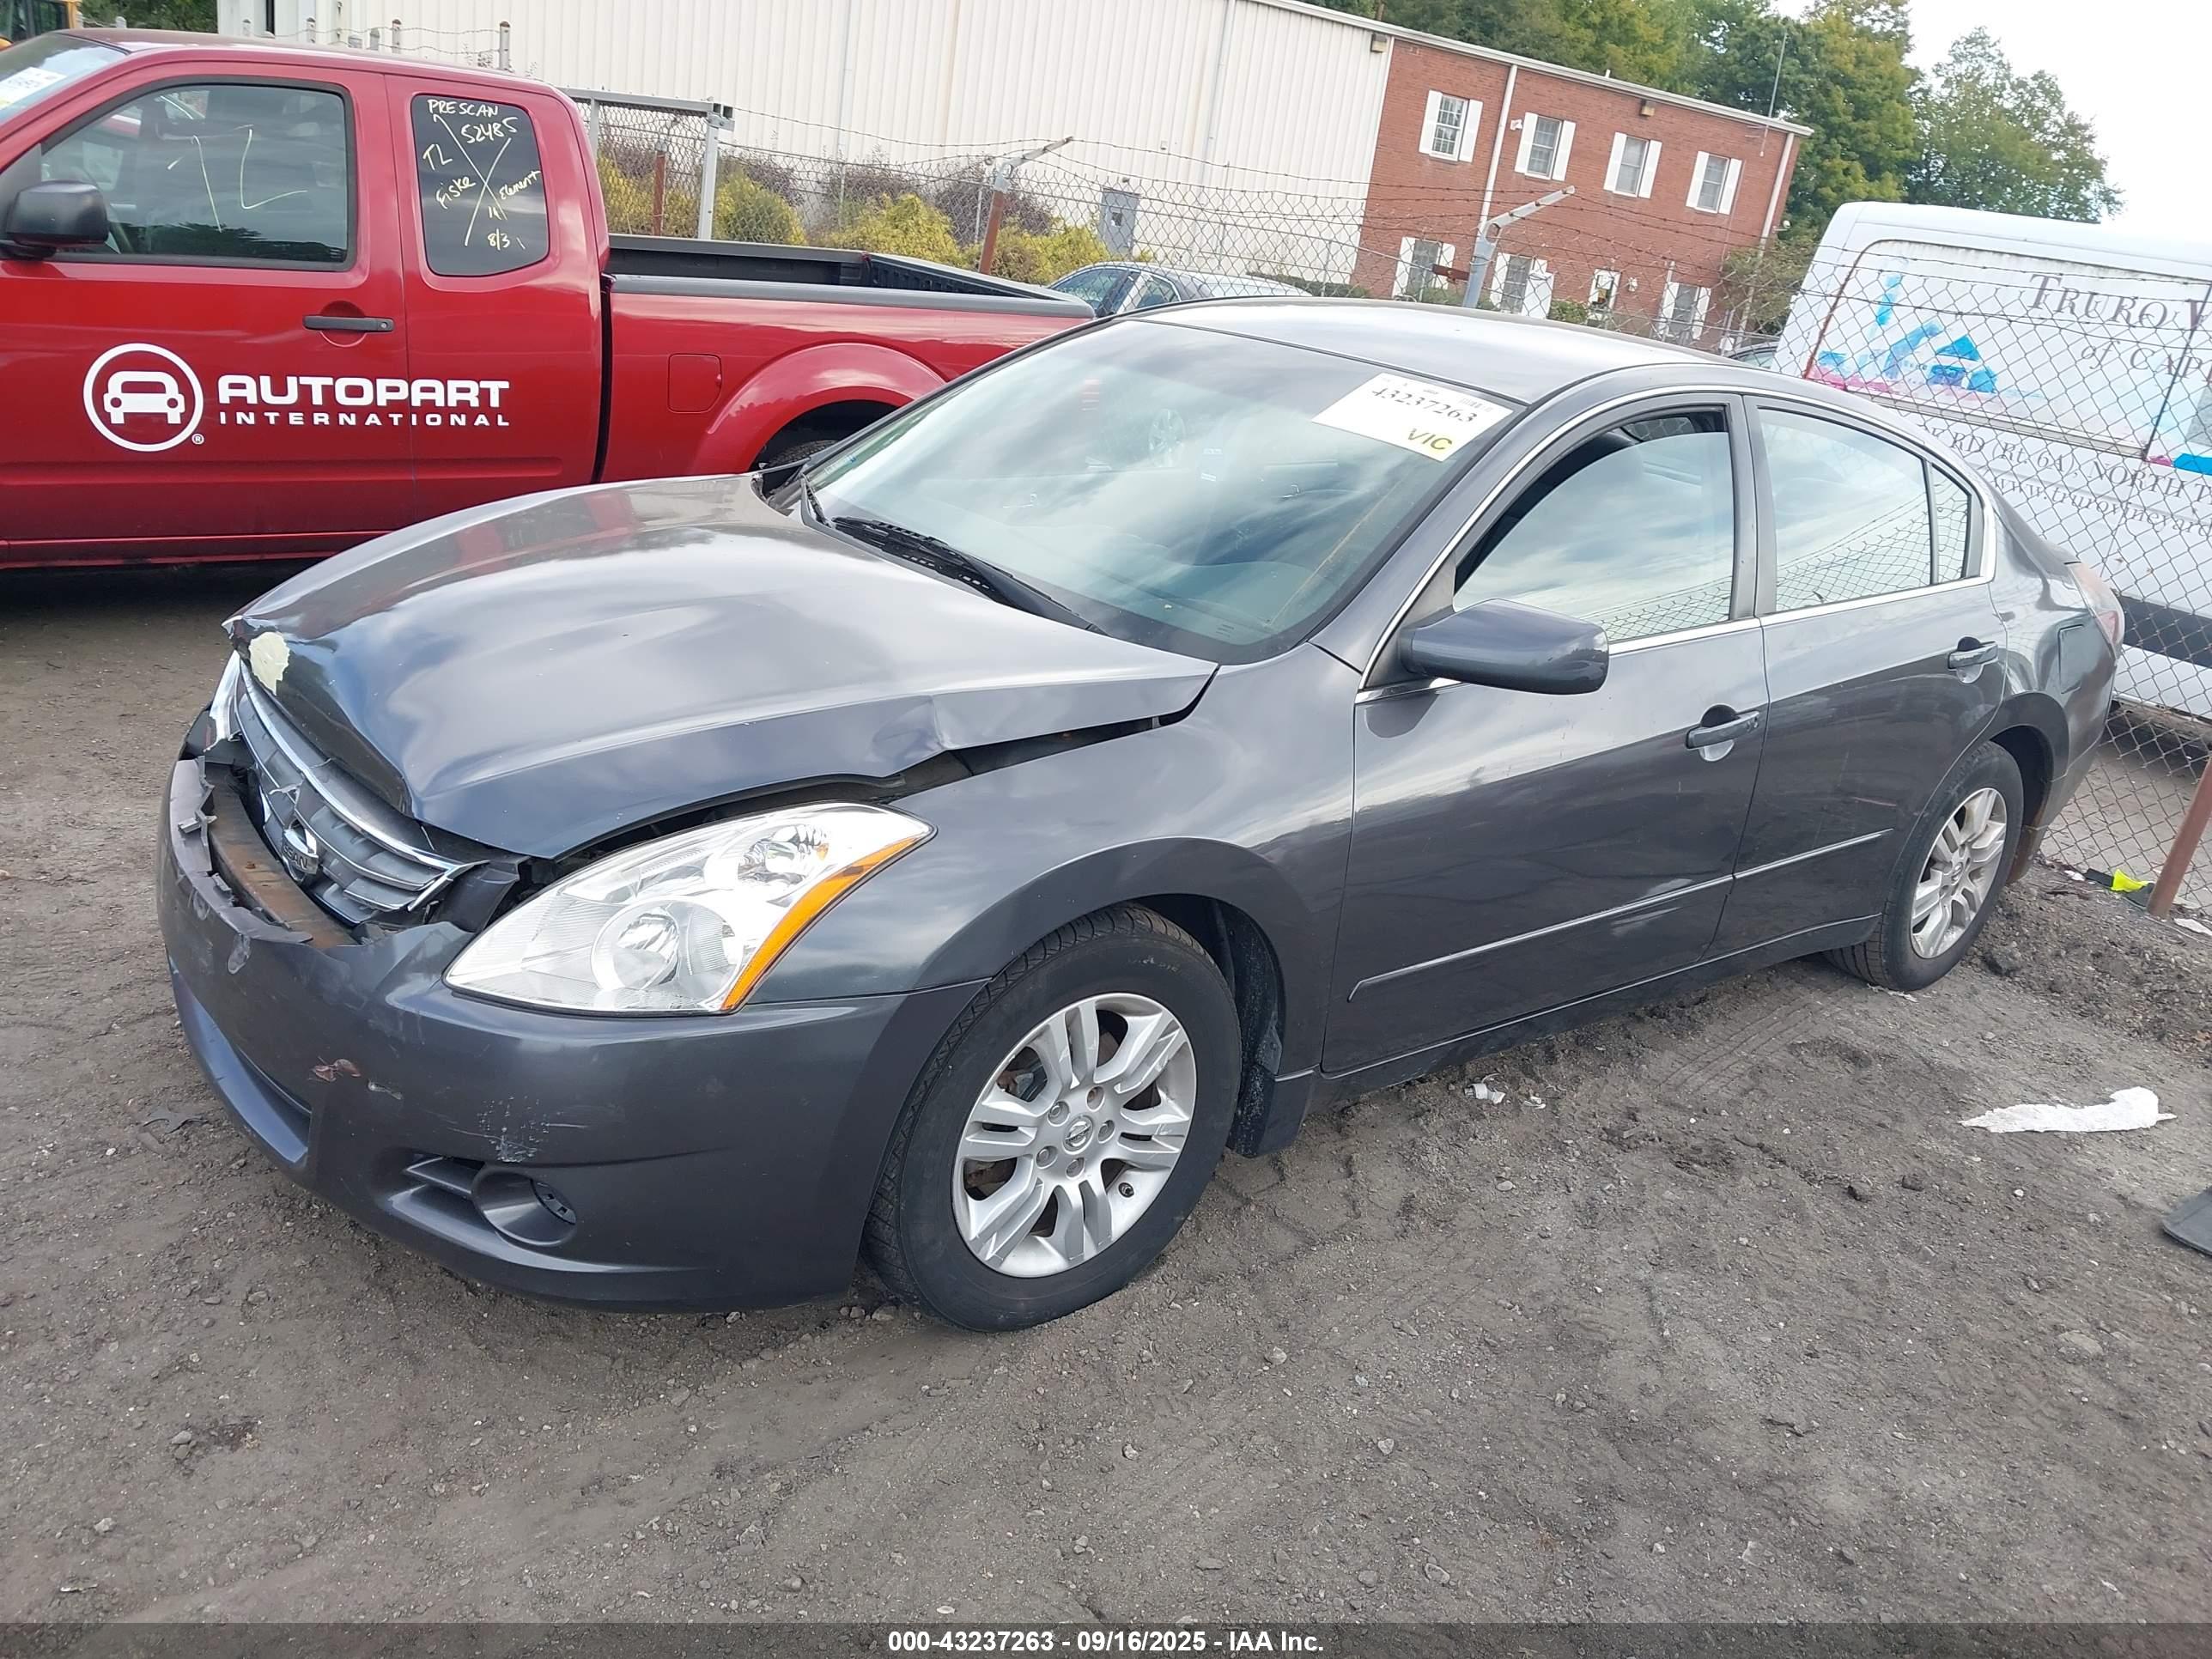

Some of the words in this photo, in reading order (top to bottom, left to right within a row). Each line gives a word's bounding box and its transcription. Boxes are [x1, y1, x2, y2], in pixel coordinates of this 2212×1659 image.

[2027, 274, 2168, 328] TRURO
[2081, 340, 2121, 369] of
[217, 374, 510, 409] AUTOPART
[1371, 387, 1478, 422] 43237263
[219, 410, 510, 427] INTERNATIONAL
[1407, 428, 1453, 451] VIC
[1949, 432, 1985, 453] RD
[1992, 441, 2027, 465] (Rt.
[2087, 459, 2187, 499] NORTH
